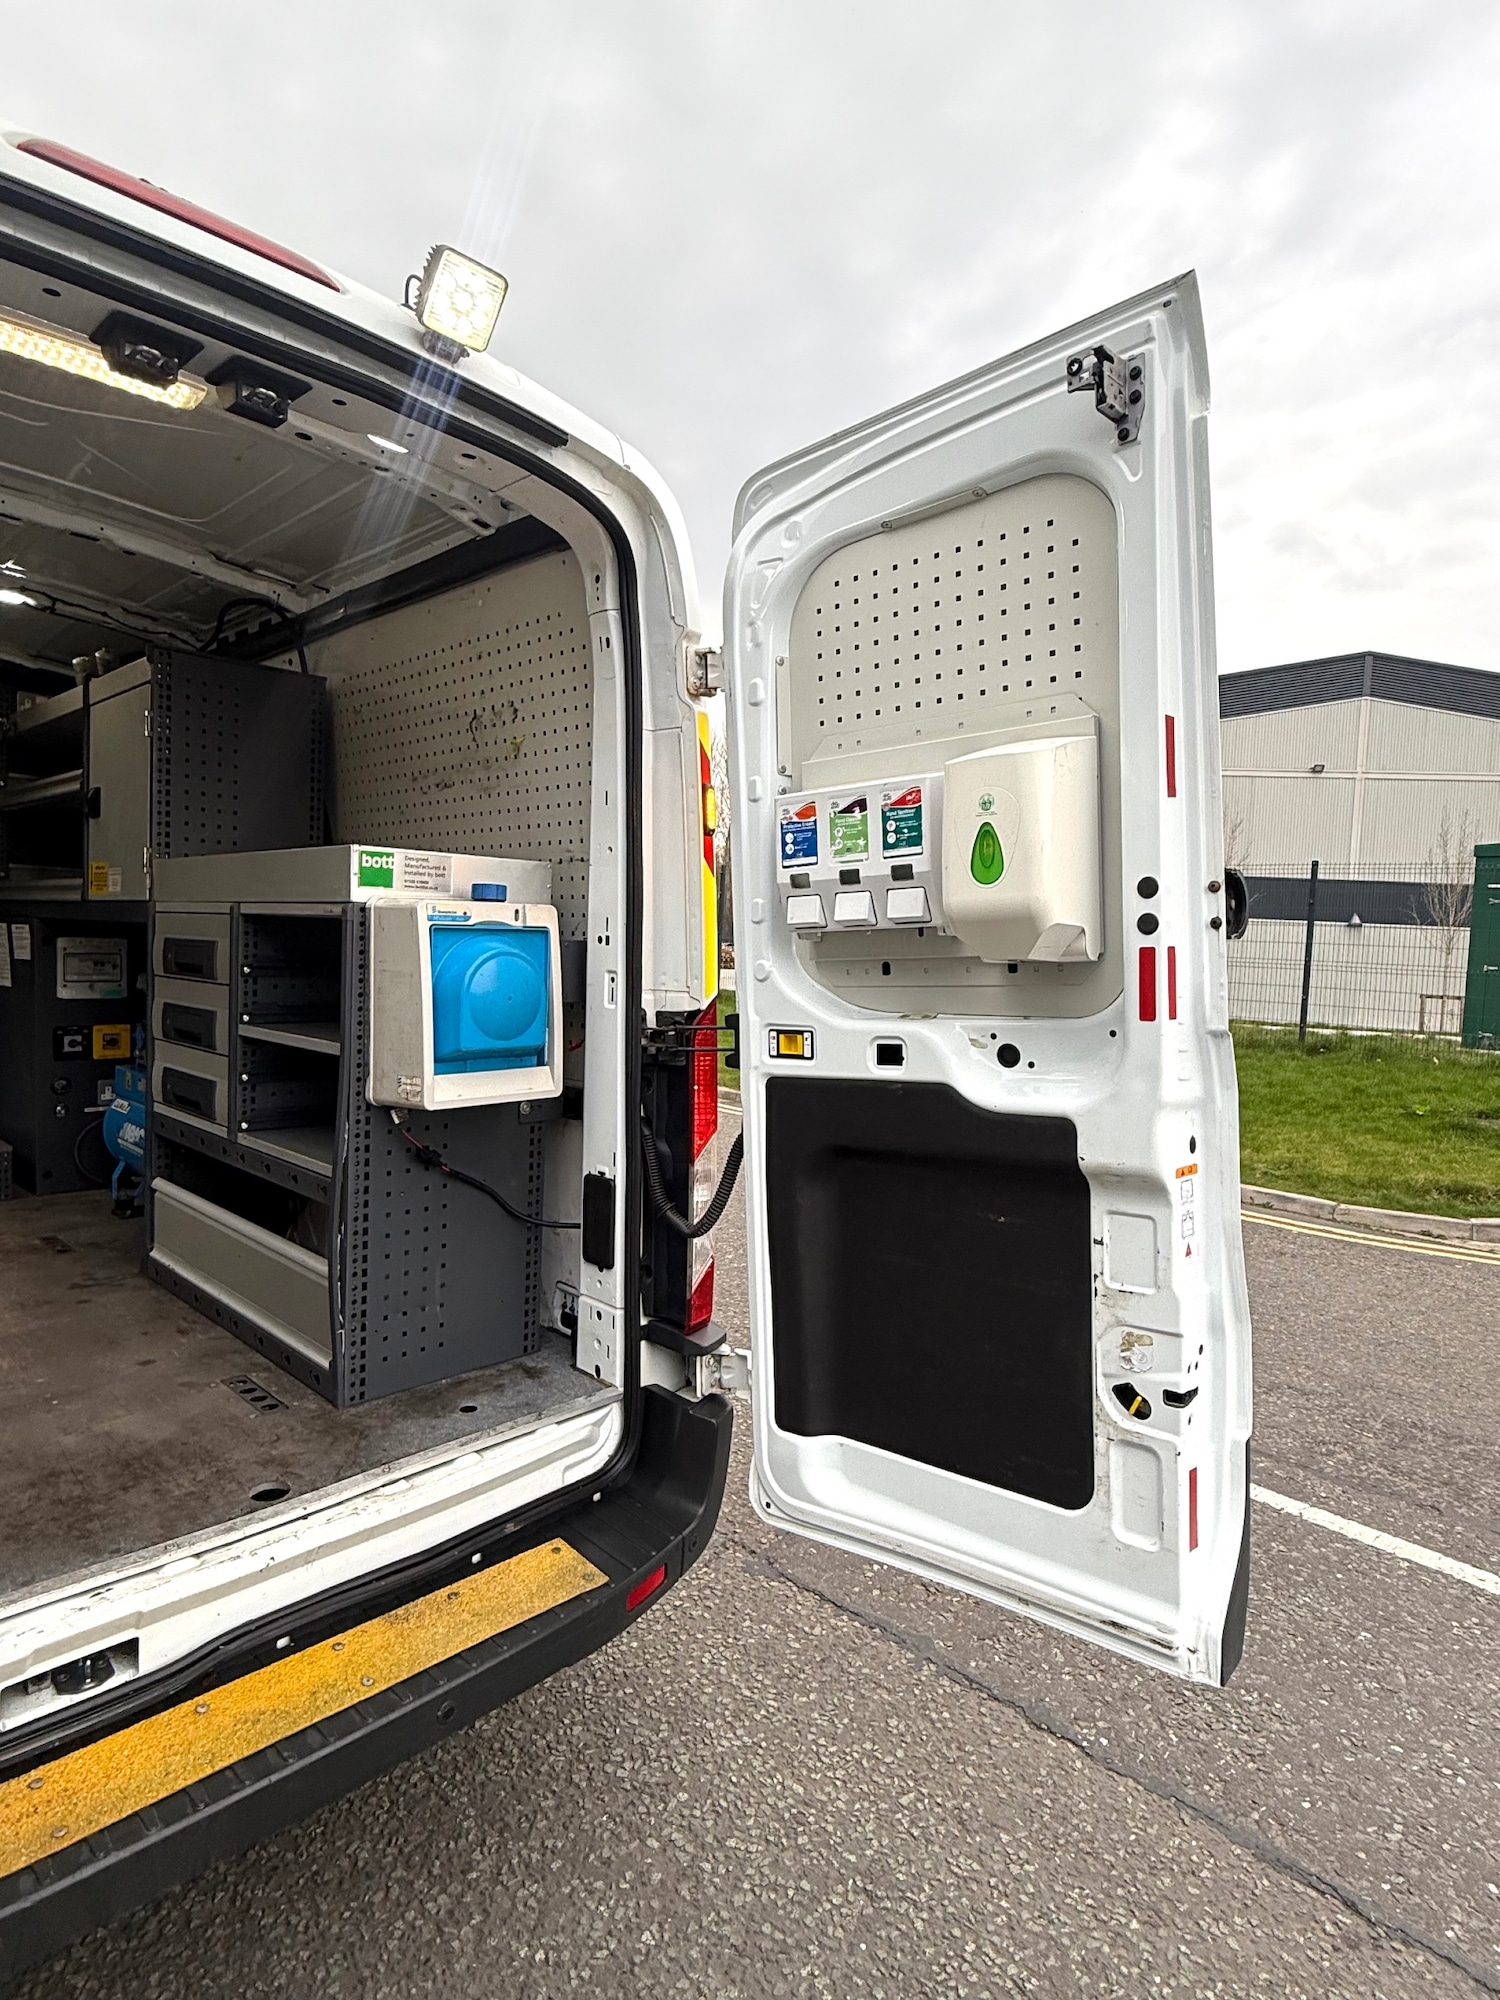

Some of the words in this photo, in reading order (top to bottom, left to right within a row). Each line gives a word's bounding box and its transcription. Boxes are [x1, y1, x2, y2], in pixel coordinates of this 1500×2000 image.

[361, 854, 395, 869] bott
[404, 855, 430, 863] Designed,
[404, 862, 441, 871] Manufactured
